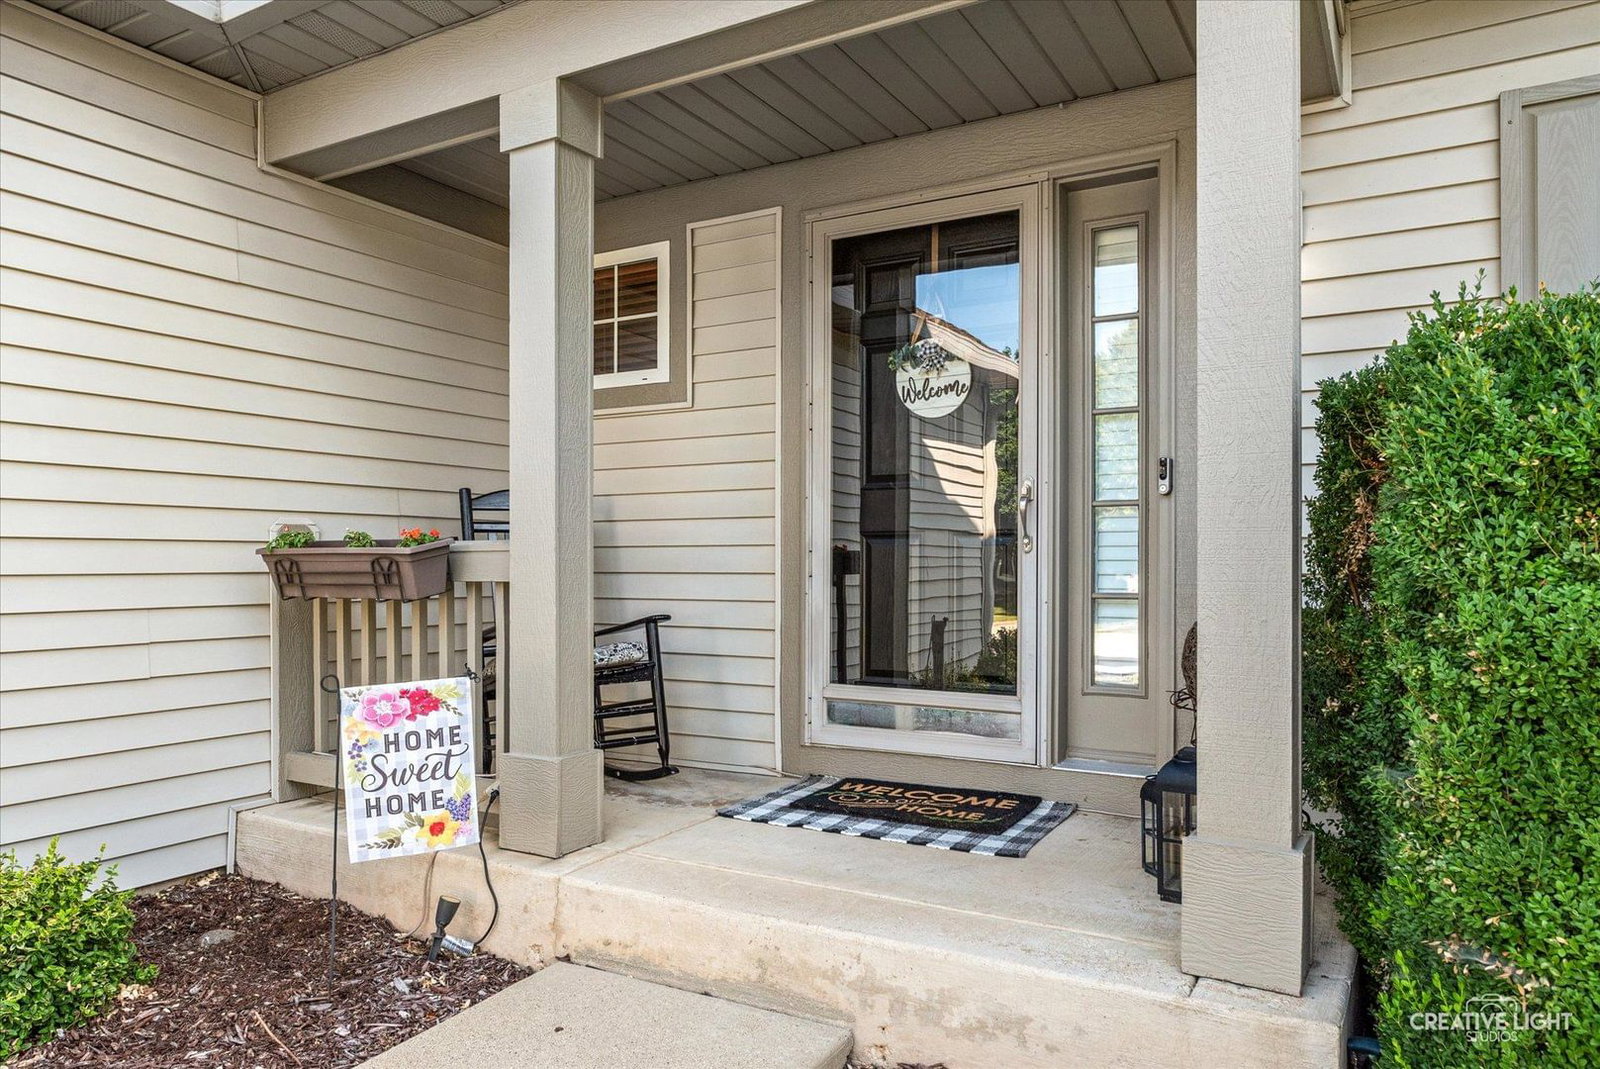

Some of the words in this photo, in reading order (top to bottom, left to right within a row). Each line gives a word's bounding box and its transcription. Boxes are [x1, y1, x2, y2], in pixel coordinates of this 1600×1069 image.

[902, 376, 969, 404] Welcome
[383, 725, 462, 753] HOME
[361, 743, 469, 792] Sweet
[365, 789, 445, 818] HOME
[840, 782, 1019, 809] WELCOME
[895, 803, 985, 820] HOME
